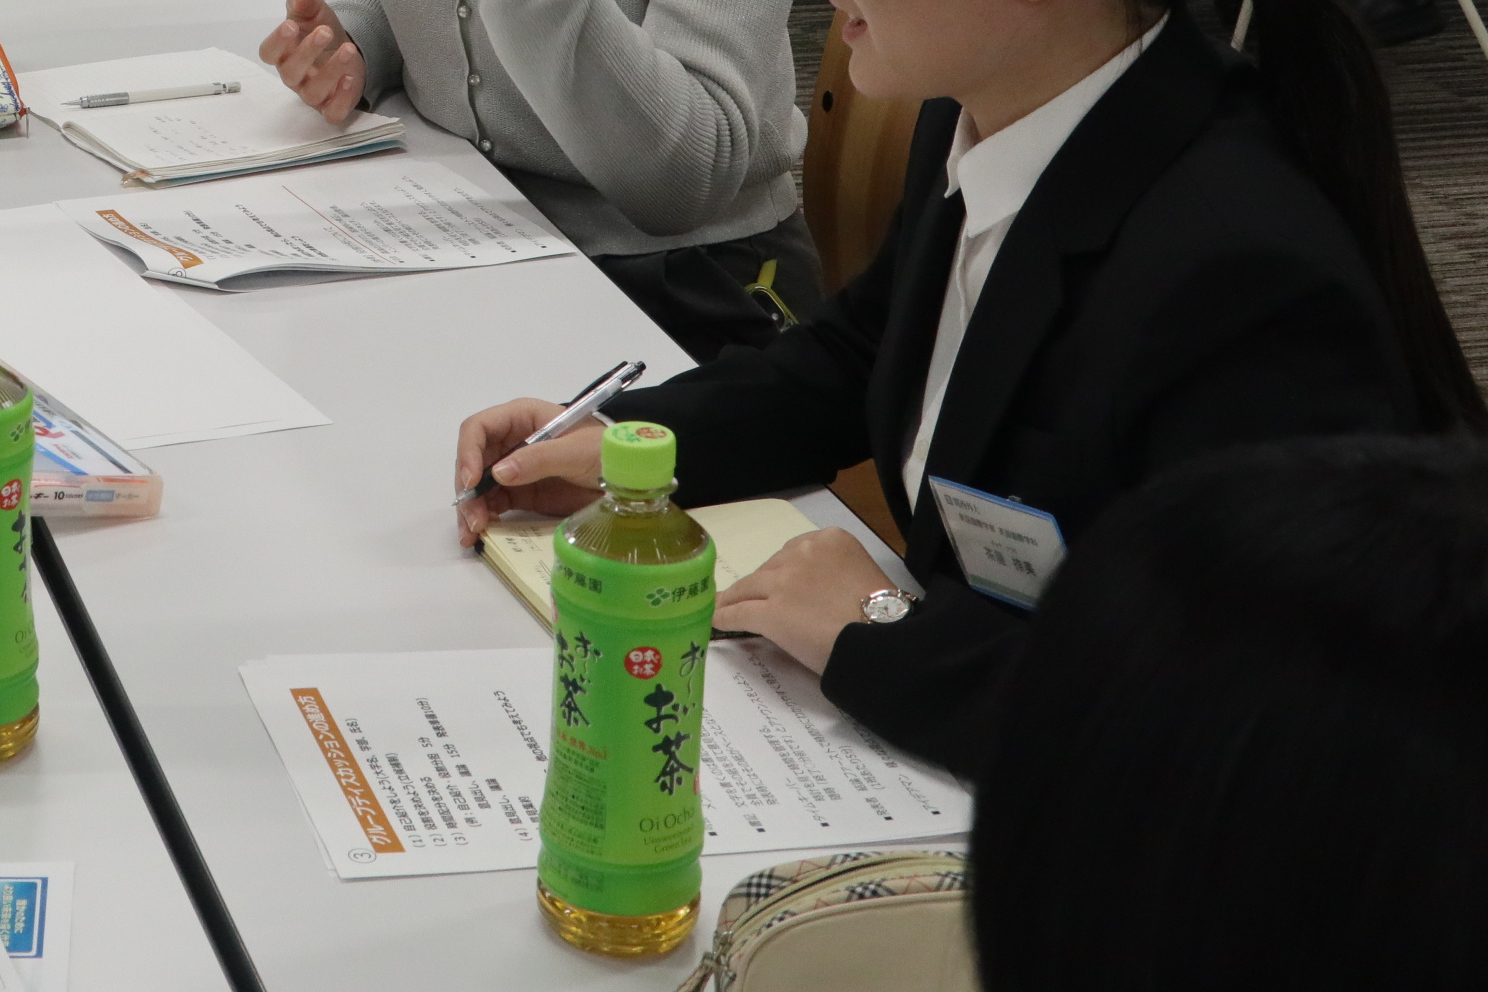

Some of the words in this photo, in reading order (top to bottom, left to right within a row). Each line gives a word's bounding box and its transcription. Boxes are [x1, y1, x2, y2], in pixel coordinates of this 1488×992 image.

[53, 491, 65, 500] 10
[671, 576, 710, 604] 伊藤園
[643, 683, 694, 796] お茶
[295, 694, 392, 844] グループディスカッションの進め方
[639, 815, 660, 835] Oi
